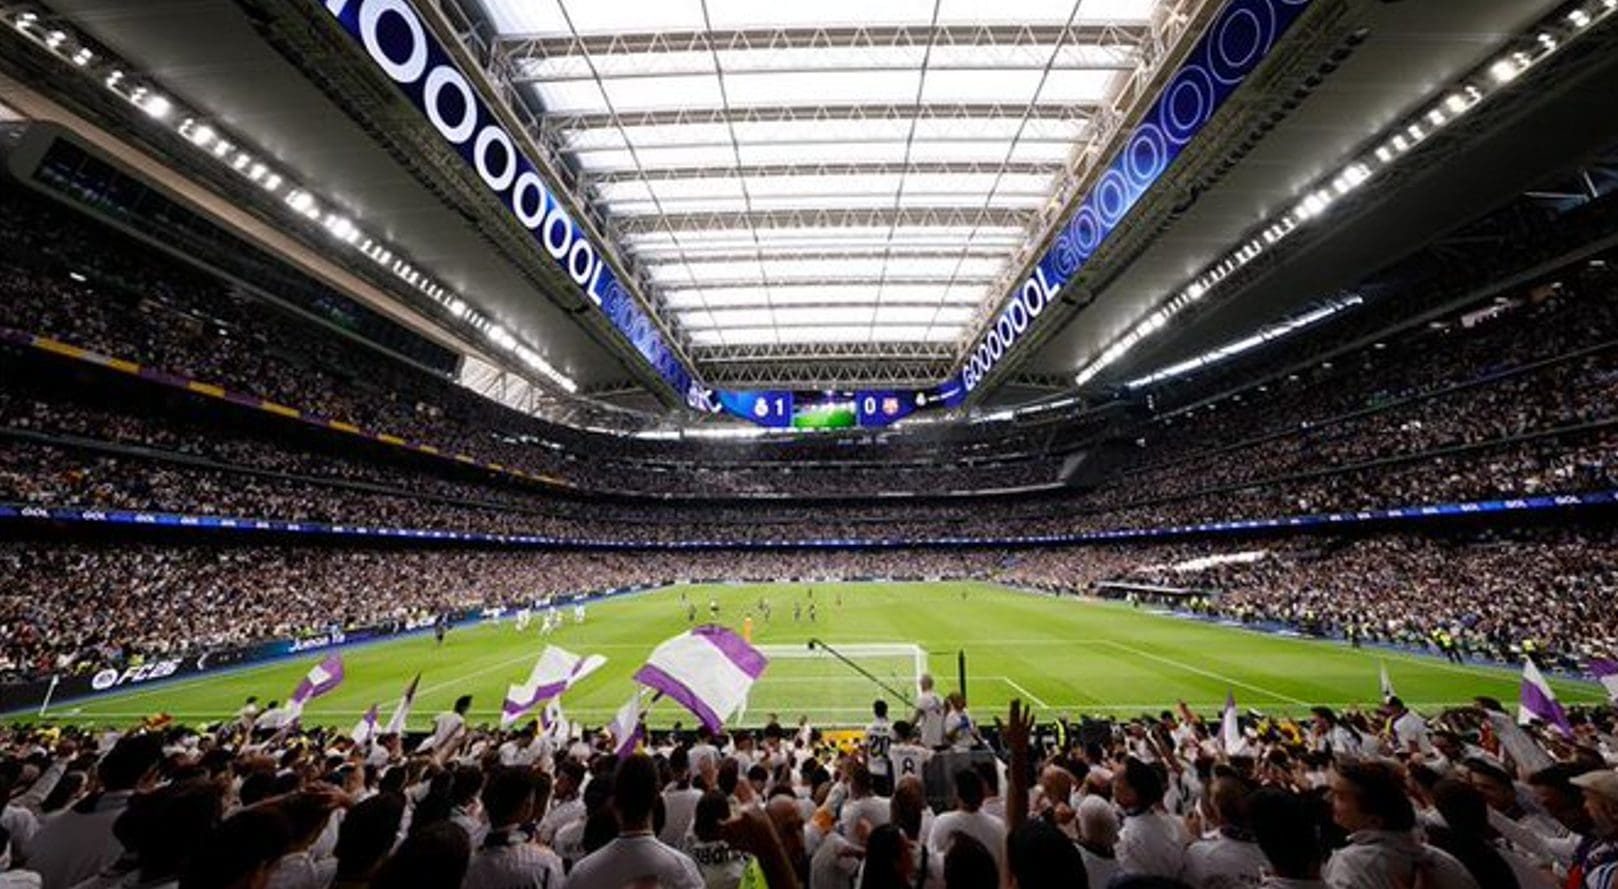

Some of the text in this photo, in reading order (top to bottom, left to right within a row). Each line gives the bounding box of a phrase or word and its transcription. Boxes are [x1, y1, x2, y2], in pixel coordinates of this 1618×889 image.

[325, 0, 603, 306] OOOOOOL
[775, 397, 876, 416] 1 0
[870, 734, 891, 758] 20
